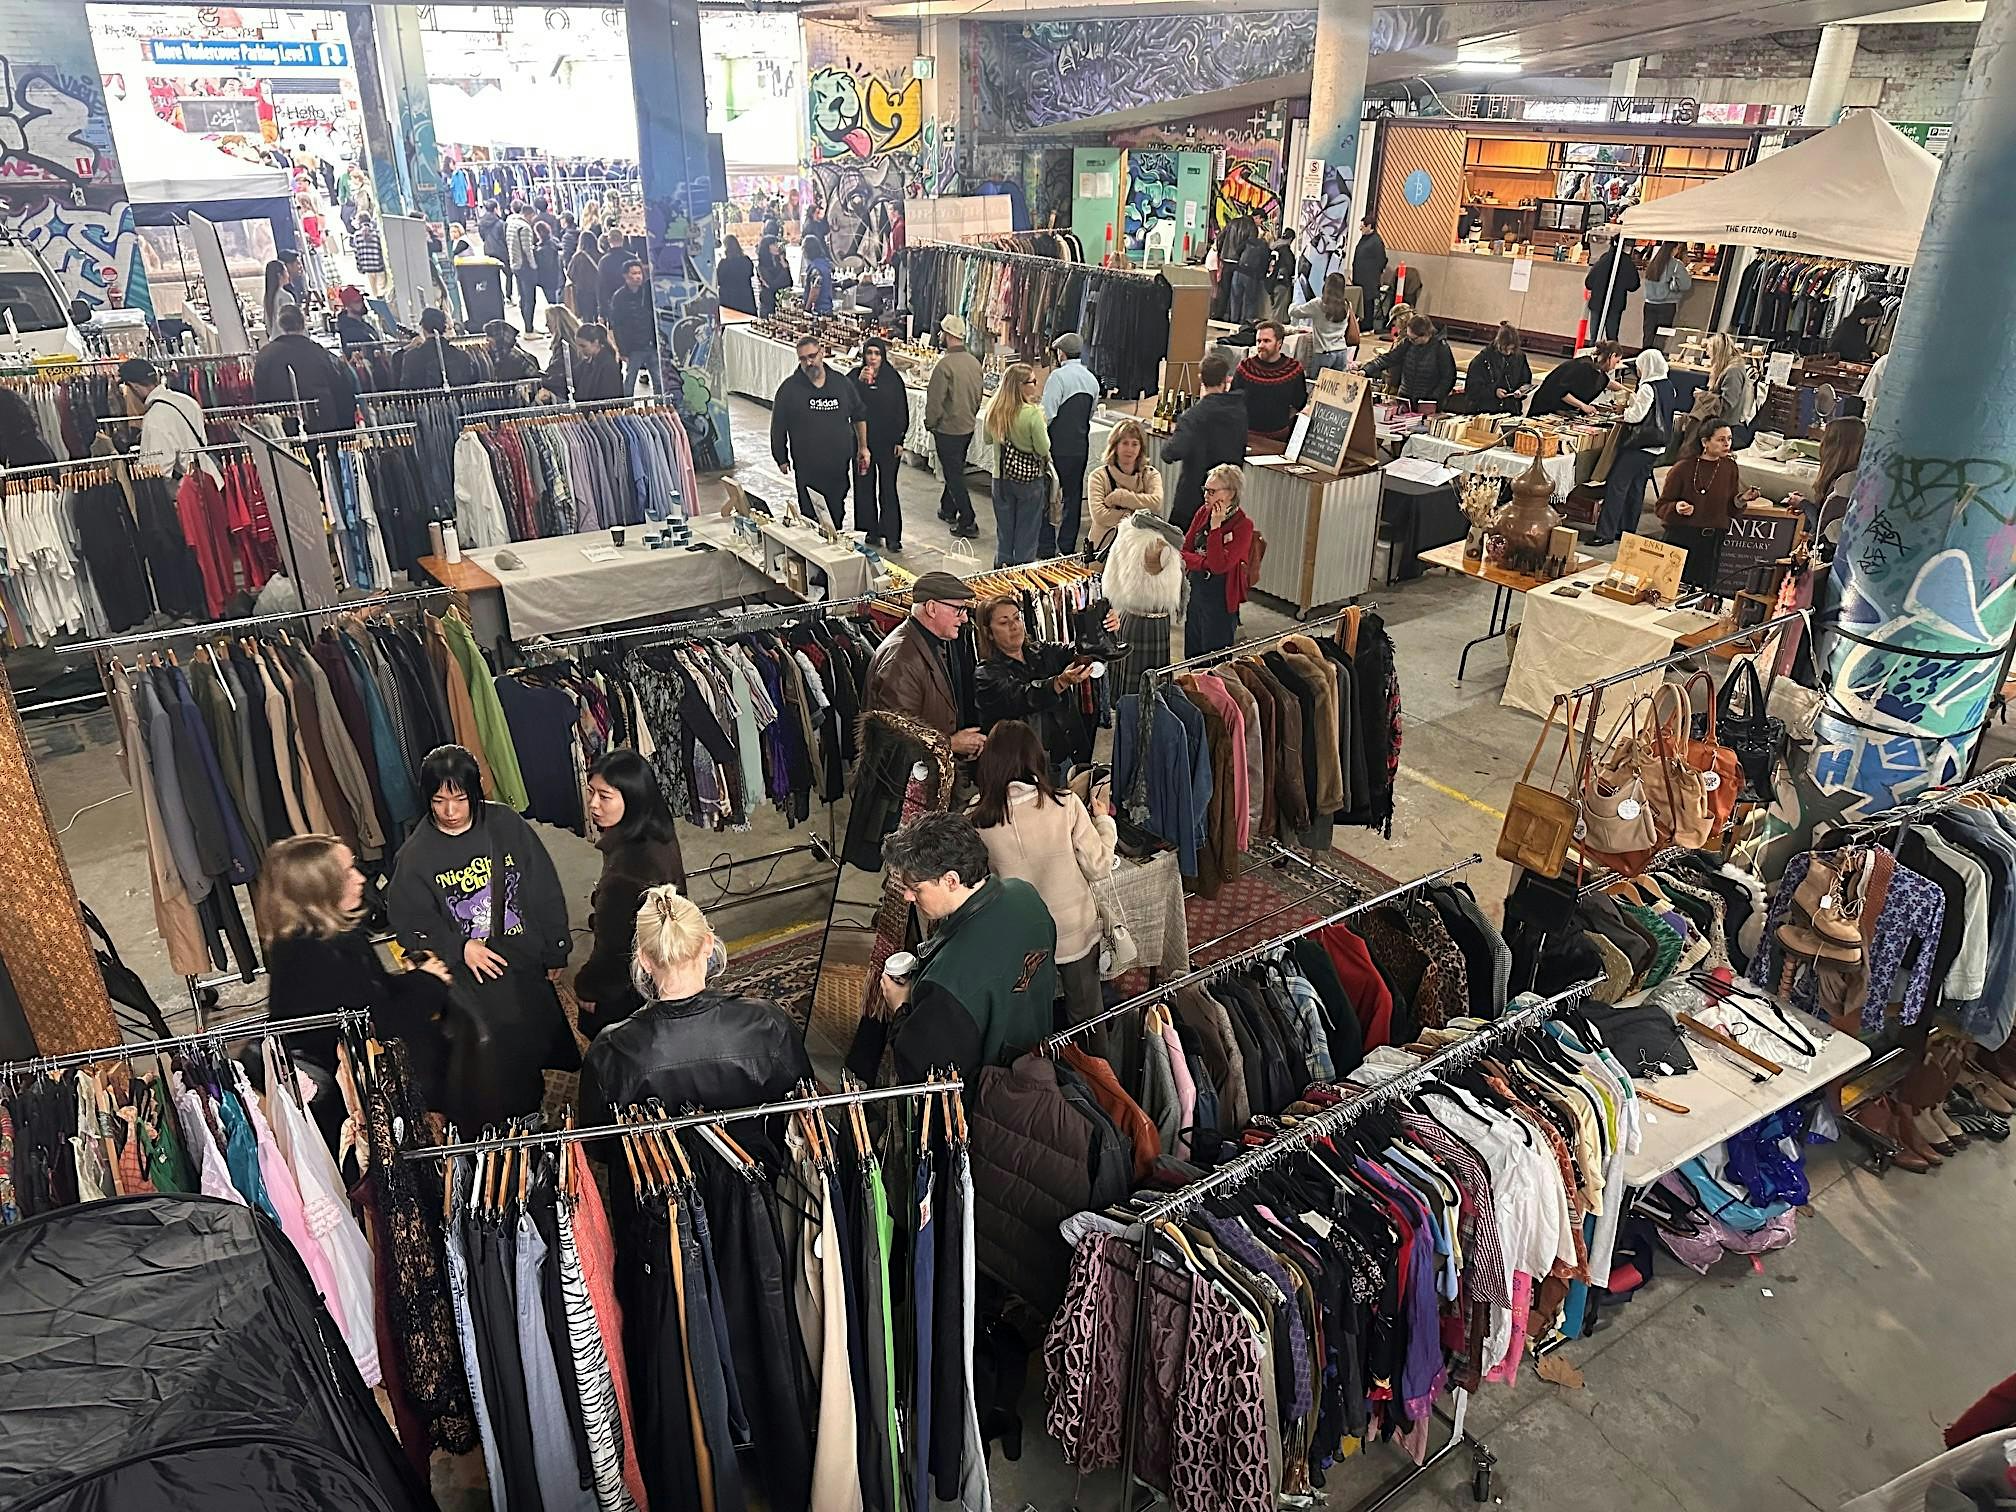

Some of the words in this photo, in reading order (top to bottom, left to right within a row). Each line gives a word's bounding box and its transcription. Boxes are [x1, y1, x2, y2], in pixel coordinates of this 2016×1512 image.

[239, 43, 280, 65] Parking
[279, 44, 306, 62] Level
[304, 45, 313, 62] 1
[1741, 225, 1774, 235] FITZROY
[1775, 229, 1798, 239] MILLS
[1320, 379, 1340, 396] WINE
[810, 399, 839, 407] adidas
[1314, 404, 1348, 429] VOLCANIC
[1727, 517, 1779, 540] NKI
[1643, 540, 1664, 552] ENKI
[1723, 540, 1771, 551] OTHECARY
[461, 867, 492, 893] Clu
